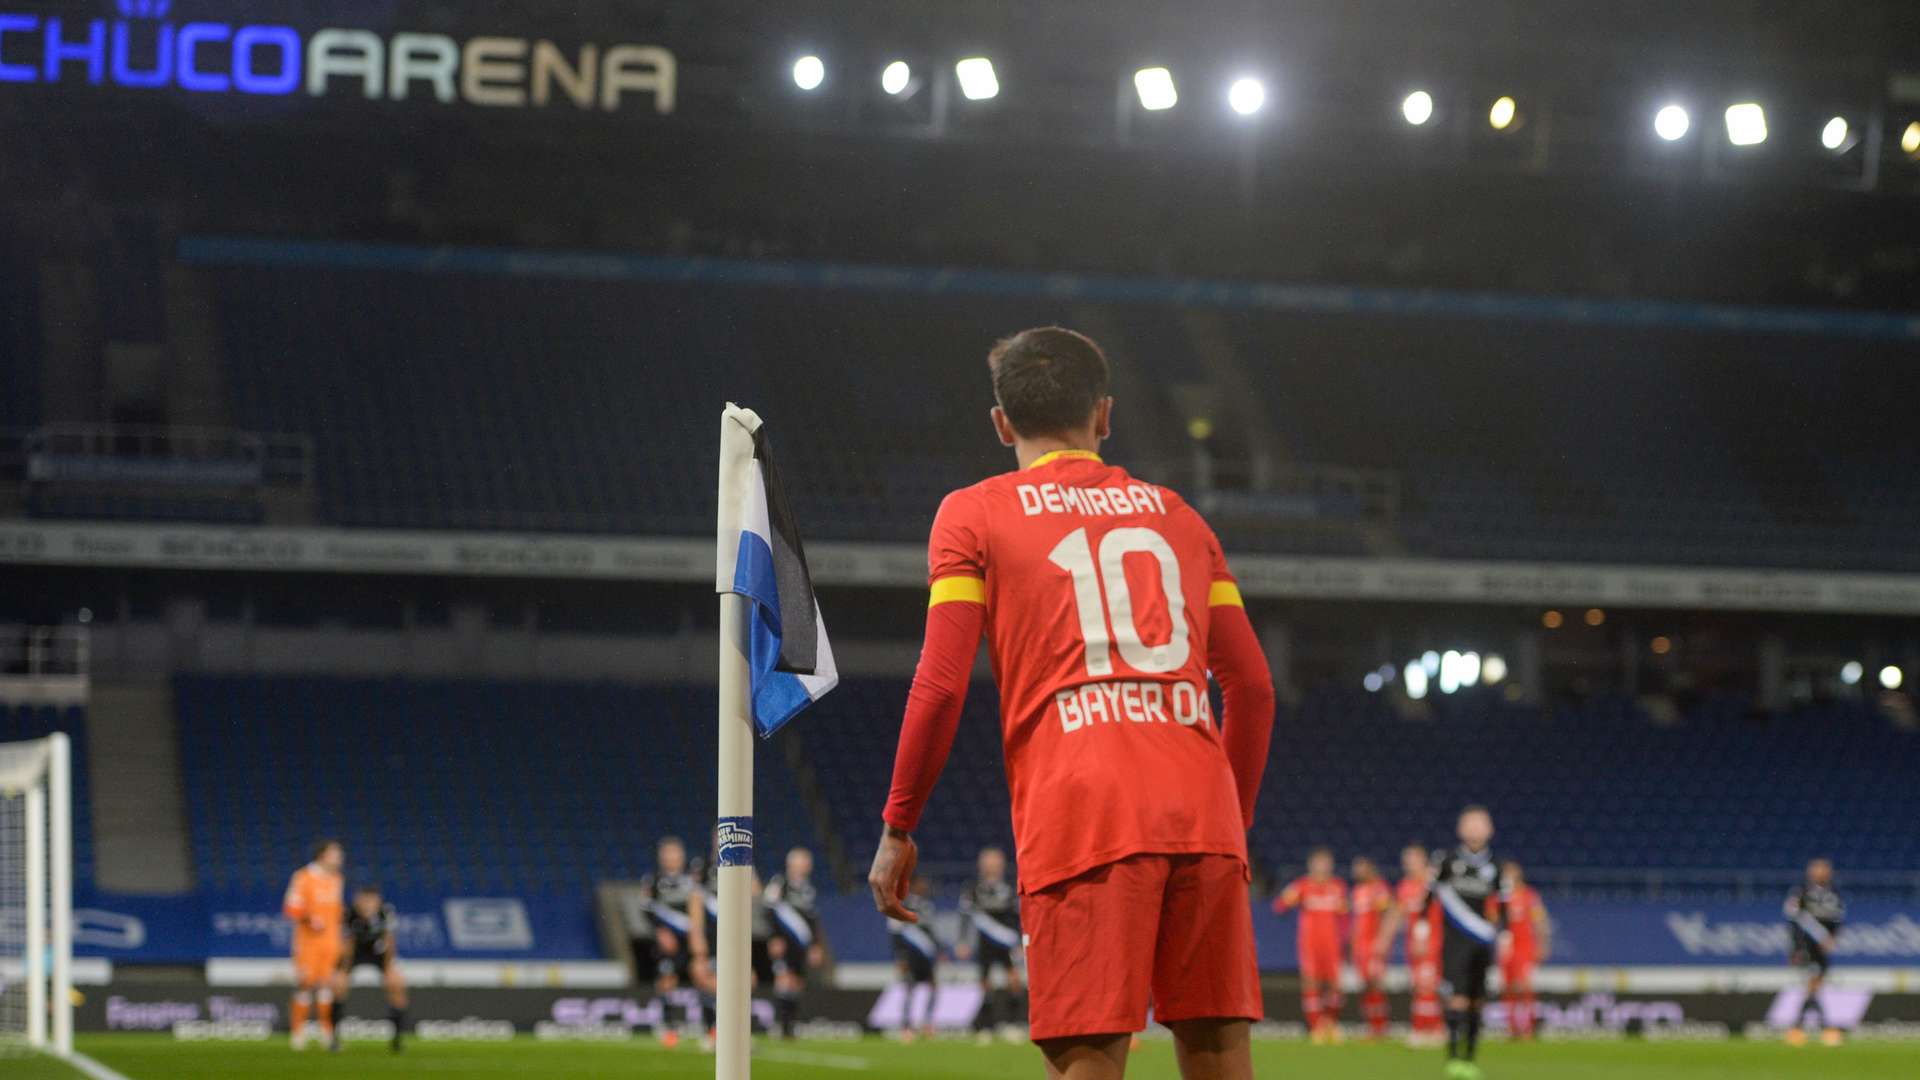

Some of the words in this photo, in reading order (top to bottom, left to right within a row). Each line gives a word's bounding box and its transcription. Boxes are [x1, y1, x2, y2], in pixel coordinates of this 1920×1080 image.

[1017, 483, 1167, 517] DEMIRBAY
[1047, 526, 1191, 678] 10
[1055, 681, 1168, 734] BAYER
